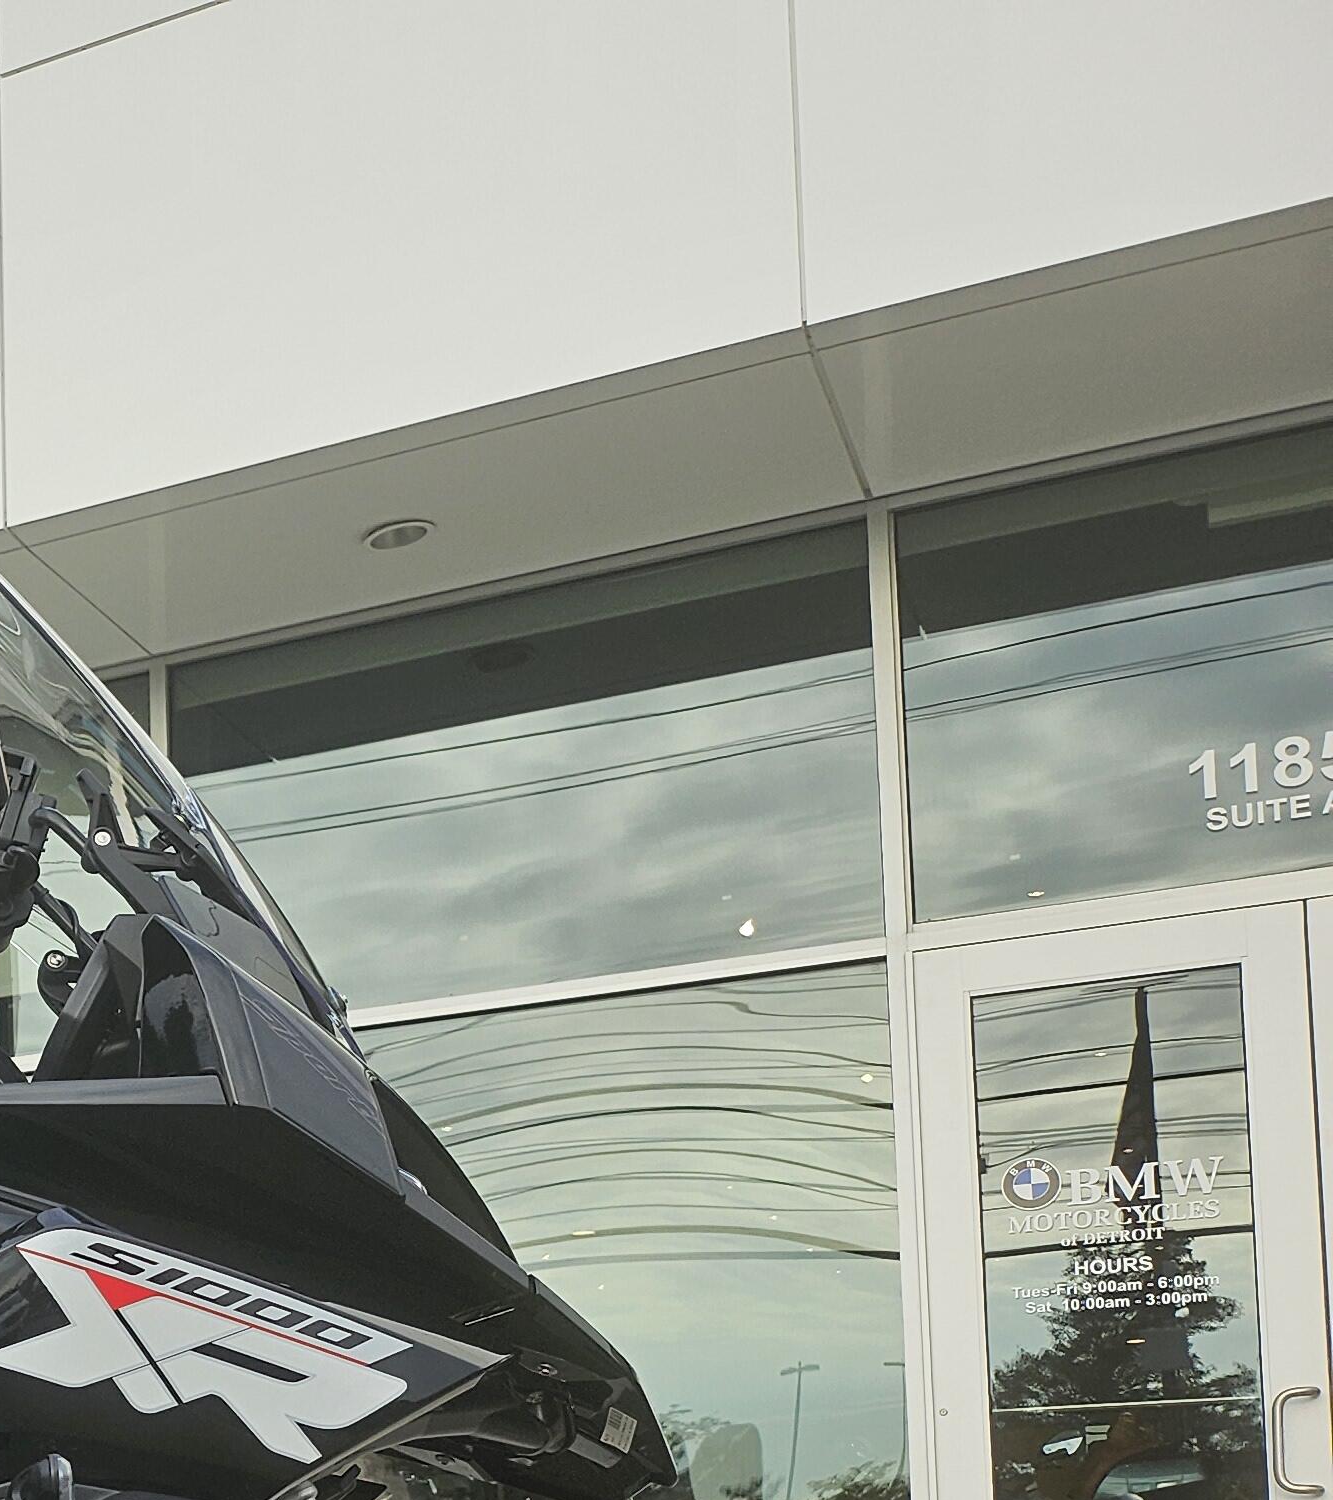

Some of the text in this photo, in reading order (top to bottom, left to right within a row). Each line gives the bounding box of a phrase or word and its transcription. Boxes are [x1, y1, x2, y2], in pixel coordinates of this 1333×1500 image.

[1206, 793, 1312, 832] SUITE
[1065, 1156, 1224, 1206] BMW
[1008, 1199, 1220, 1234] MOTORCYCLES
[1061, 1226, 1165, 1247] of DETROIT
[1074, 1255, 1153, 1275] HOURS
[71, 1242, 376, 1351] S1000
[1012, 1282, 1078, 1299] Tues-Fri
[1082, 1280, 1143, 1295] 9:00am
[1157, 1274, 1220, 1290] 6:00pm
[1025, 1302, 1052, 1314] Sat
[1062, 1297, 1130, 1312] 10:00am
[1145, 1291, 1208, 1306] 3:00pm
